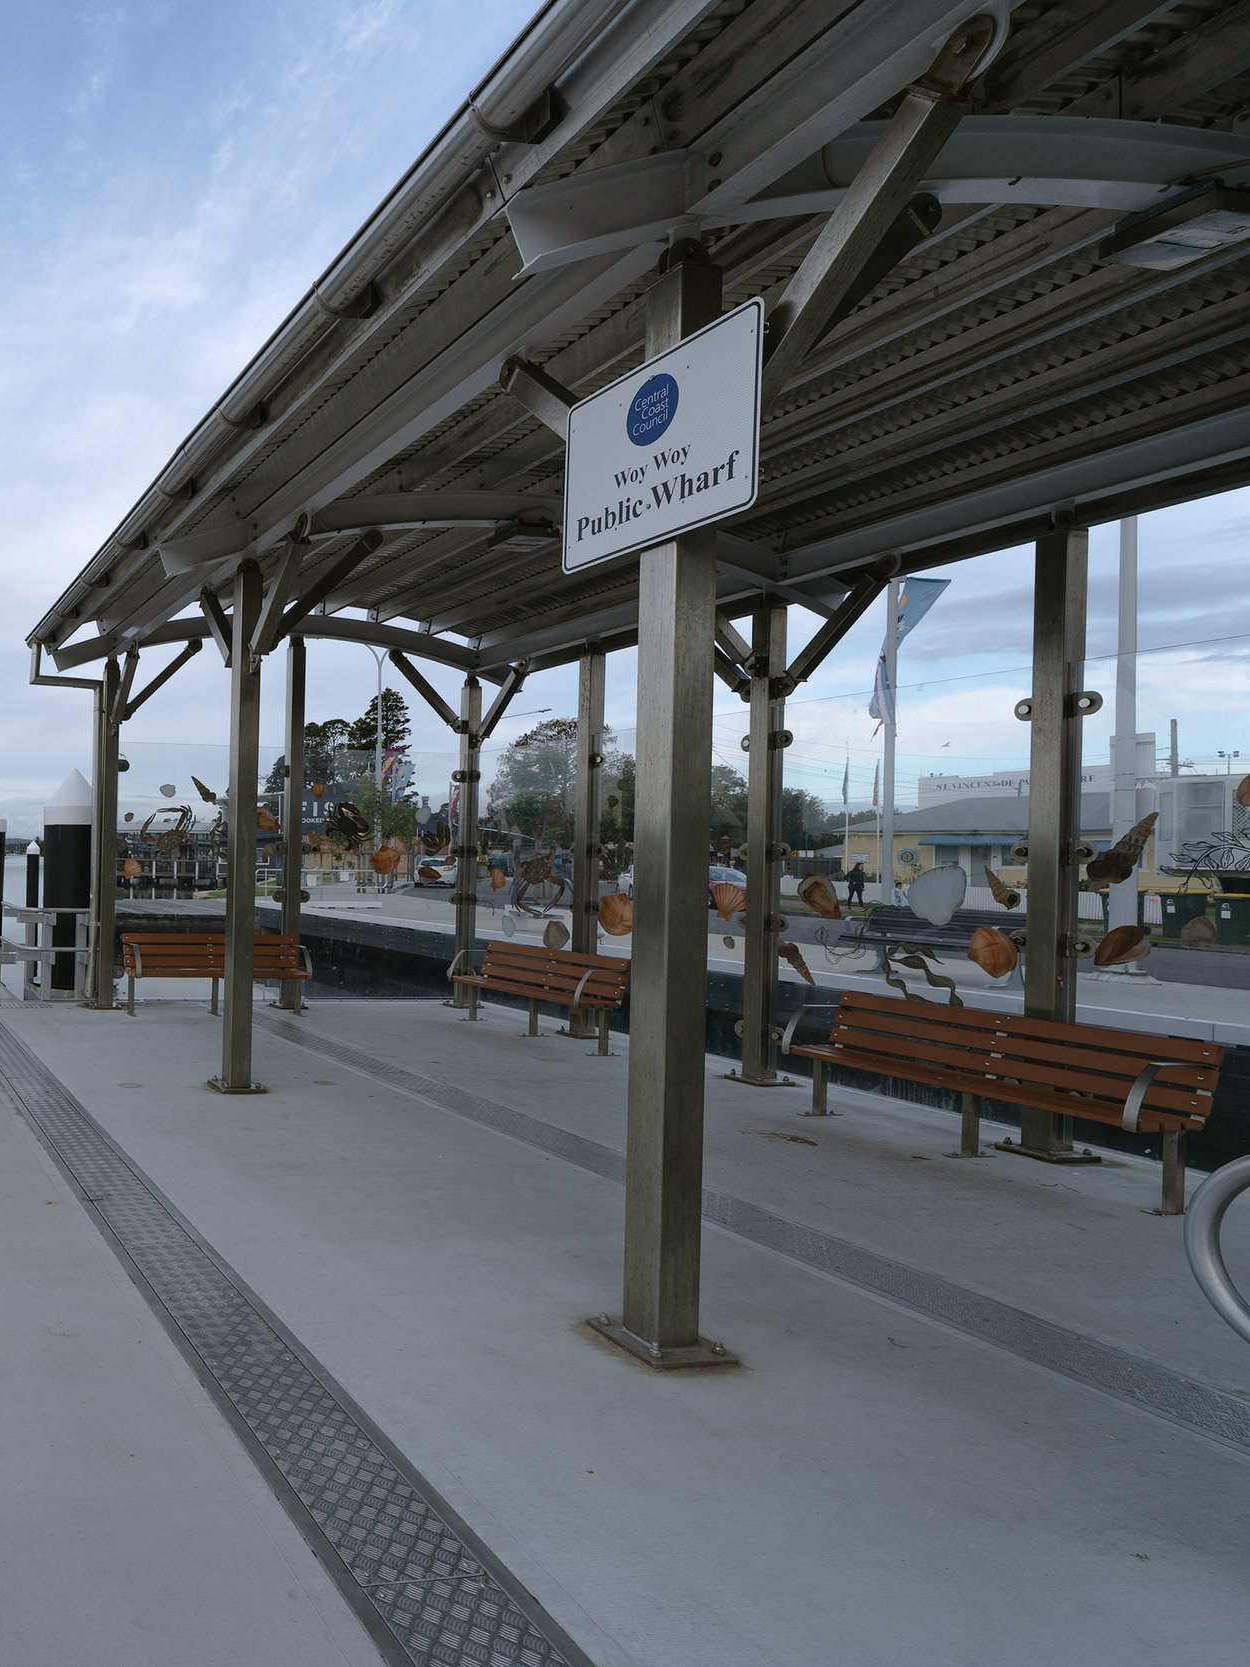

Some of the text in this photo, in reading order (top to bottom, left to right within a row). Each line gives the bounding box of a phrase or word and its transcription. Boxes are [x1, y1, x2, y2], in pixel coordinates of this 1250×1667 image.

[634, 383, 669, 411] Central
[641, 397, 669, 420] Coast
[632, 408, 669, 436] Council
[613, 444, 691, 489] Woy Woy
[576, 449, 740, 542] Public Wharf
